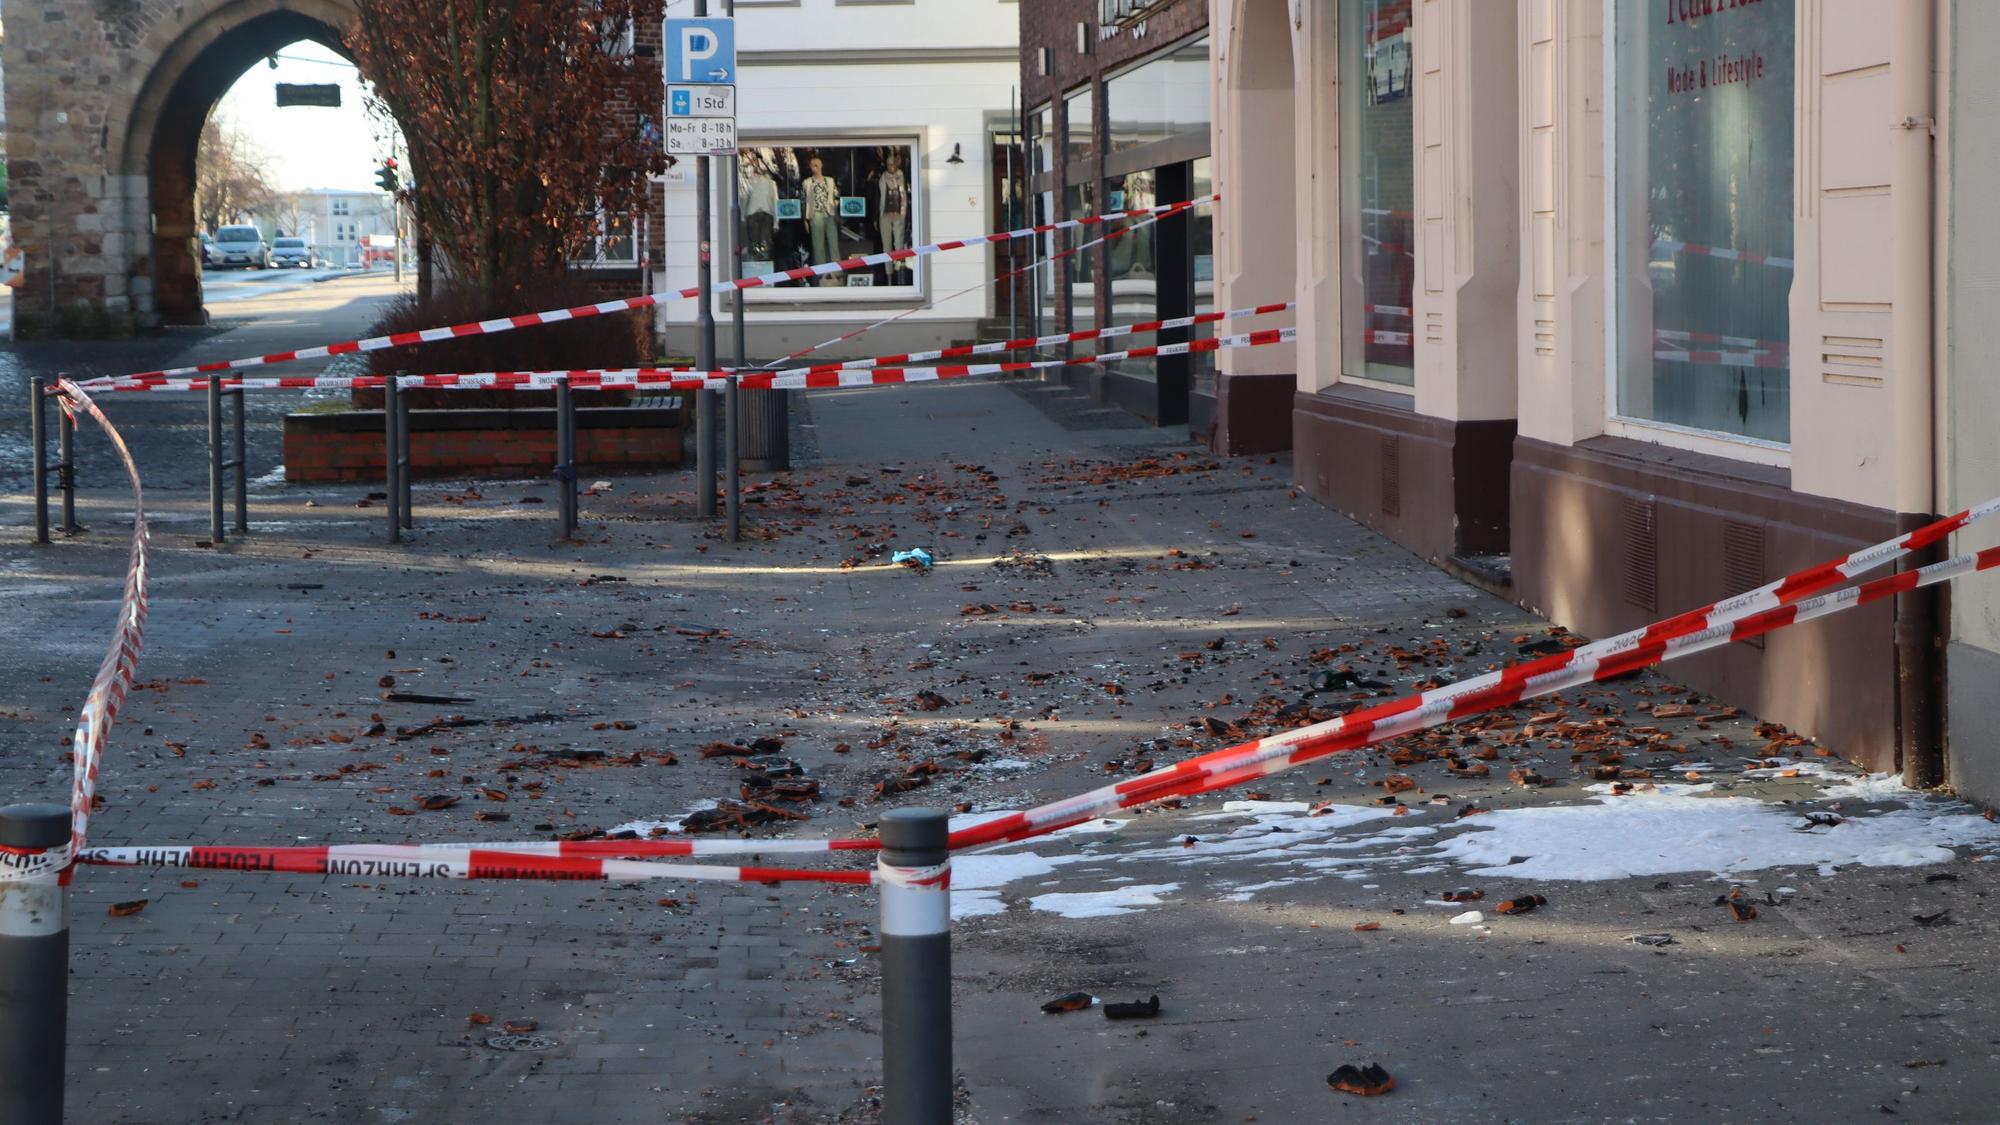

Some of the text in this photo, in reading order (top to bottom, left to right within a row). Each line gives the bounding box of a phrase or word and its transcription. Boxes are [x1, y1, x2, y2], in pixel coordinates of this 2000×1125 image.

[681, 27, 719, 80] P
[1667, 50, 1763, 94] Mode & Lifestyle
[670, 138, 681, 149] Sa
[136, 848, 275, 871] FEUERWEHR
[316, 858, 450, 879] SPERRZONE
